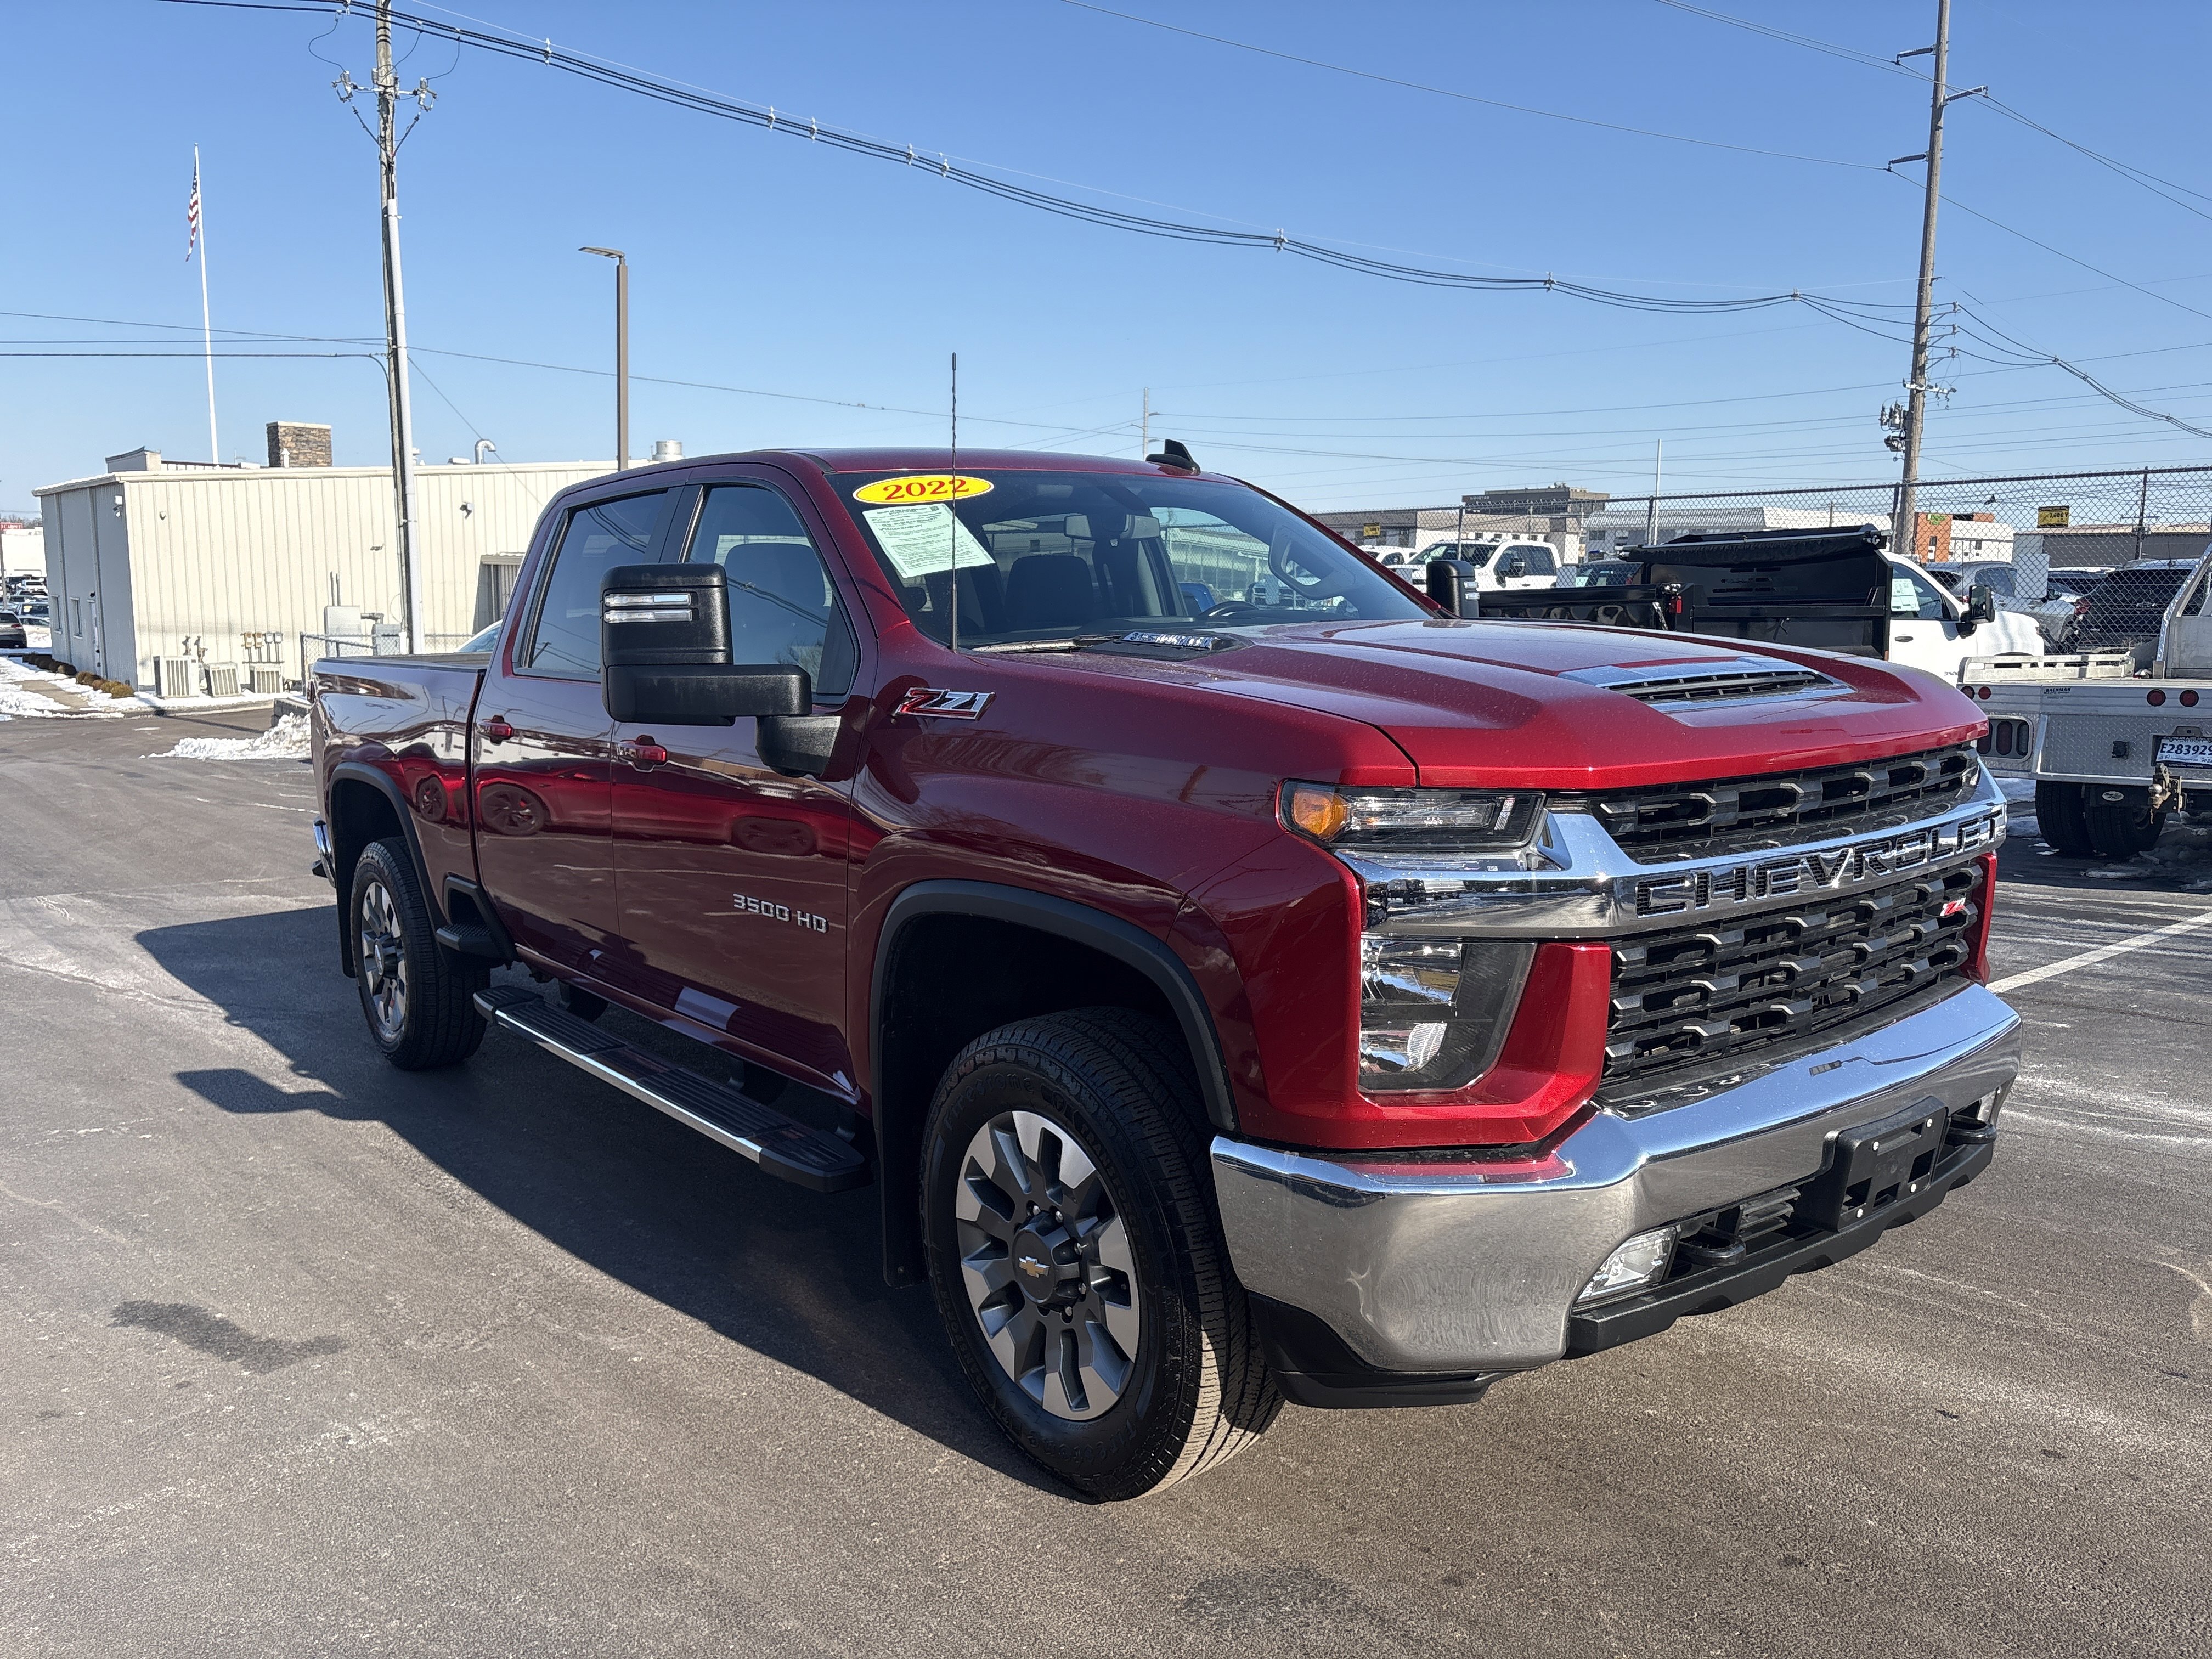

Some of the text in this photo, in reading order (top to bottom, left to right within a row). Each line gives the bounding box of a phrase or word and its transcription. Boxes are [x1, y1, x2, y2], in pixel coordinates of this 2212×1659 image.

[883, 479, 969, 500] 2022
[893, 687, 996, 719] Z71
[1635, 804, 2005, 918] CHEVROLET
[732, 893, 828, 933] 3500 HD
